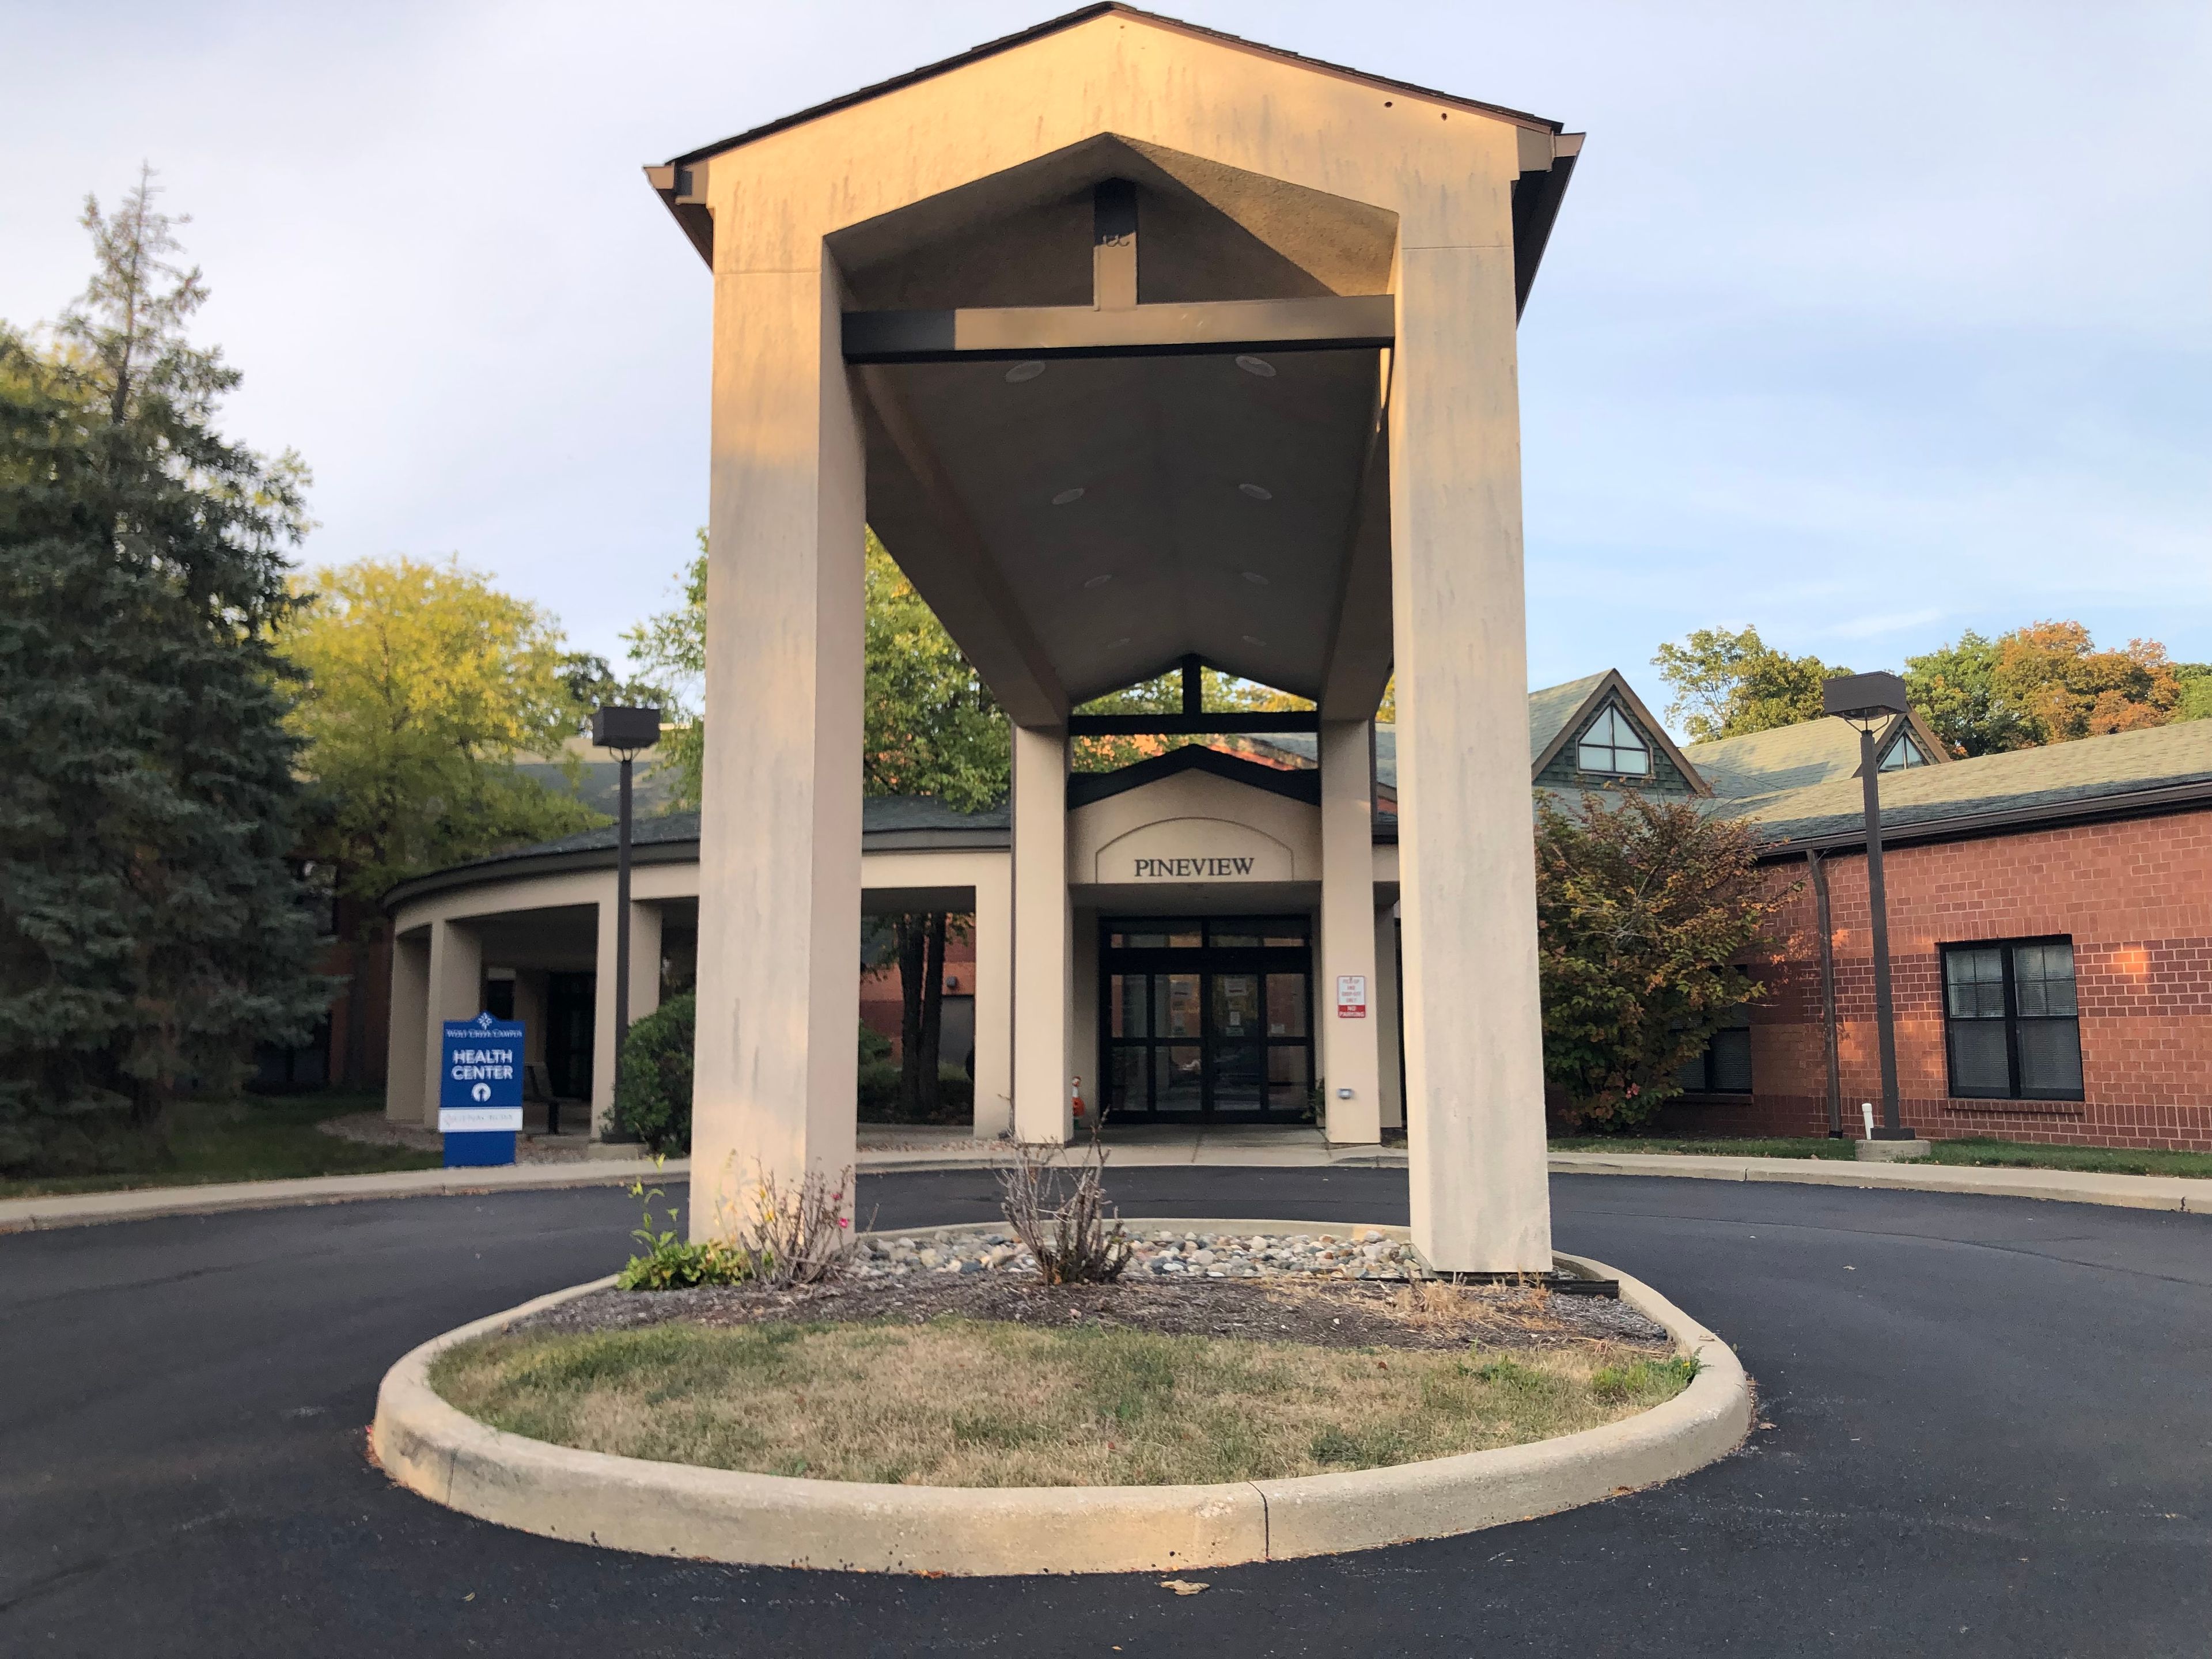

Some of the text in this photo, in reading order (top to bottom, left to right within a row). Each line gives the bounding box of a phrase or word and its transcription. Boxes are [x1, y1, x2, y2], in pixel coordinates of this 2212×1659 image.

[1134, 857, 1255, 877] PINEVIEW
[493, 1028, 522, 1038] CAMPUS
[453, 1049, 513, 1064] HEALTH
[451, 1065, 513, 1080] CENTER
